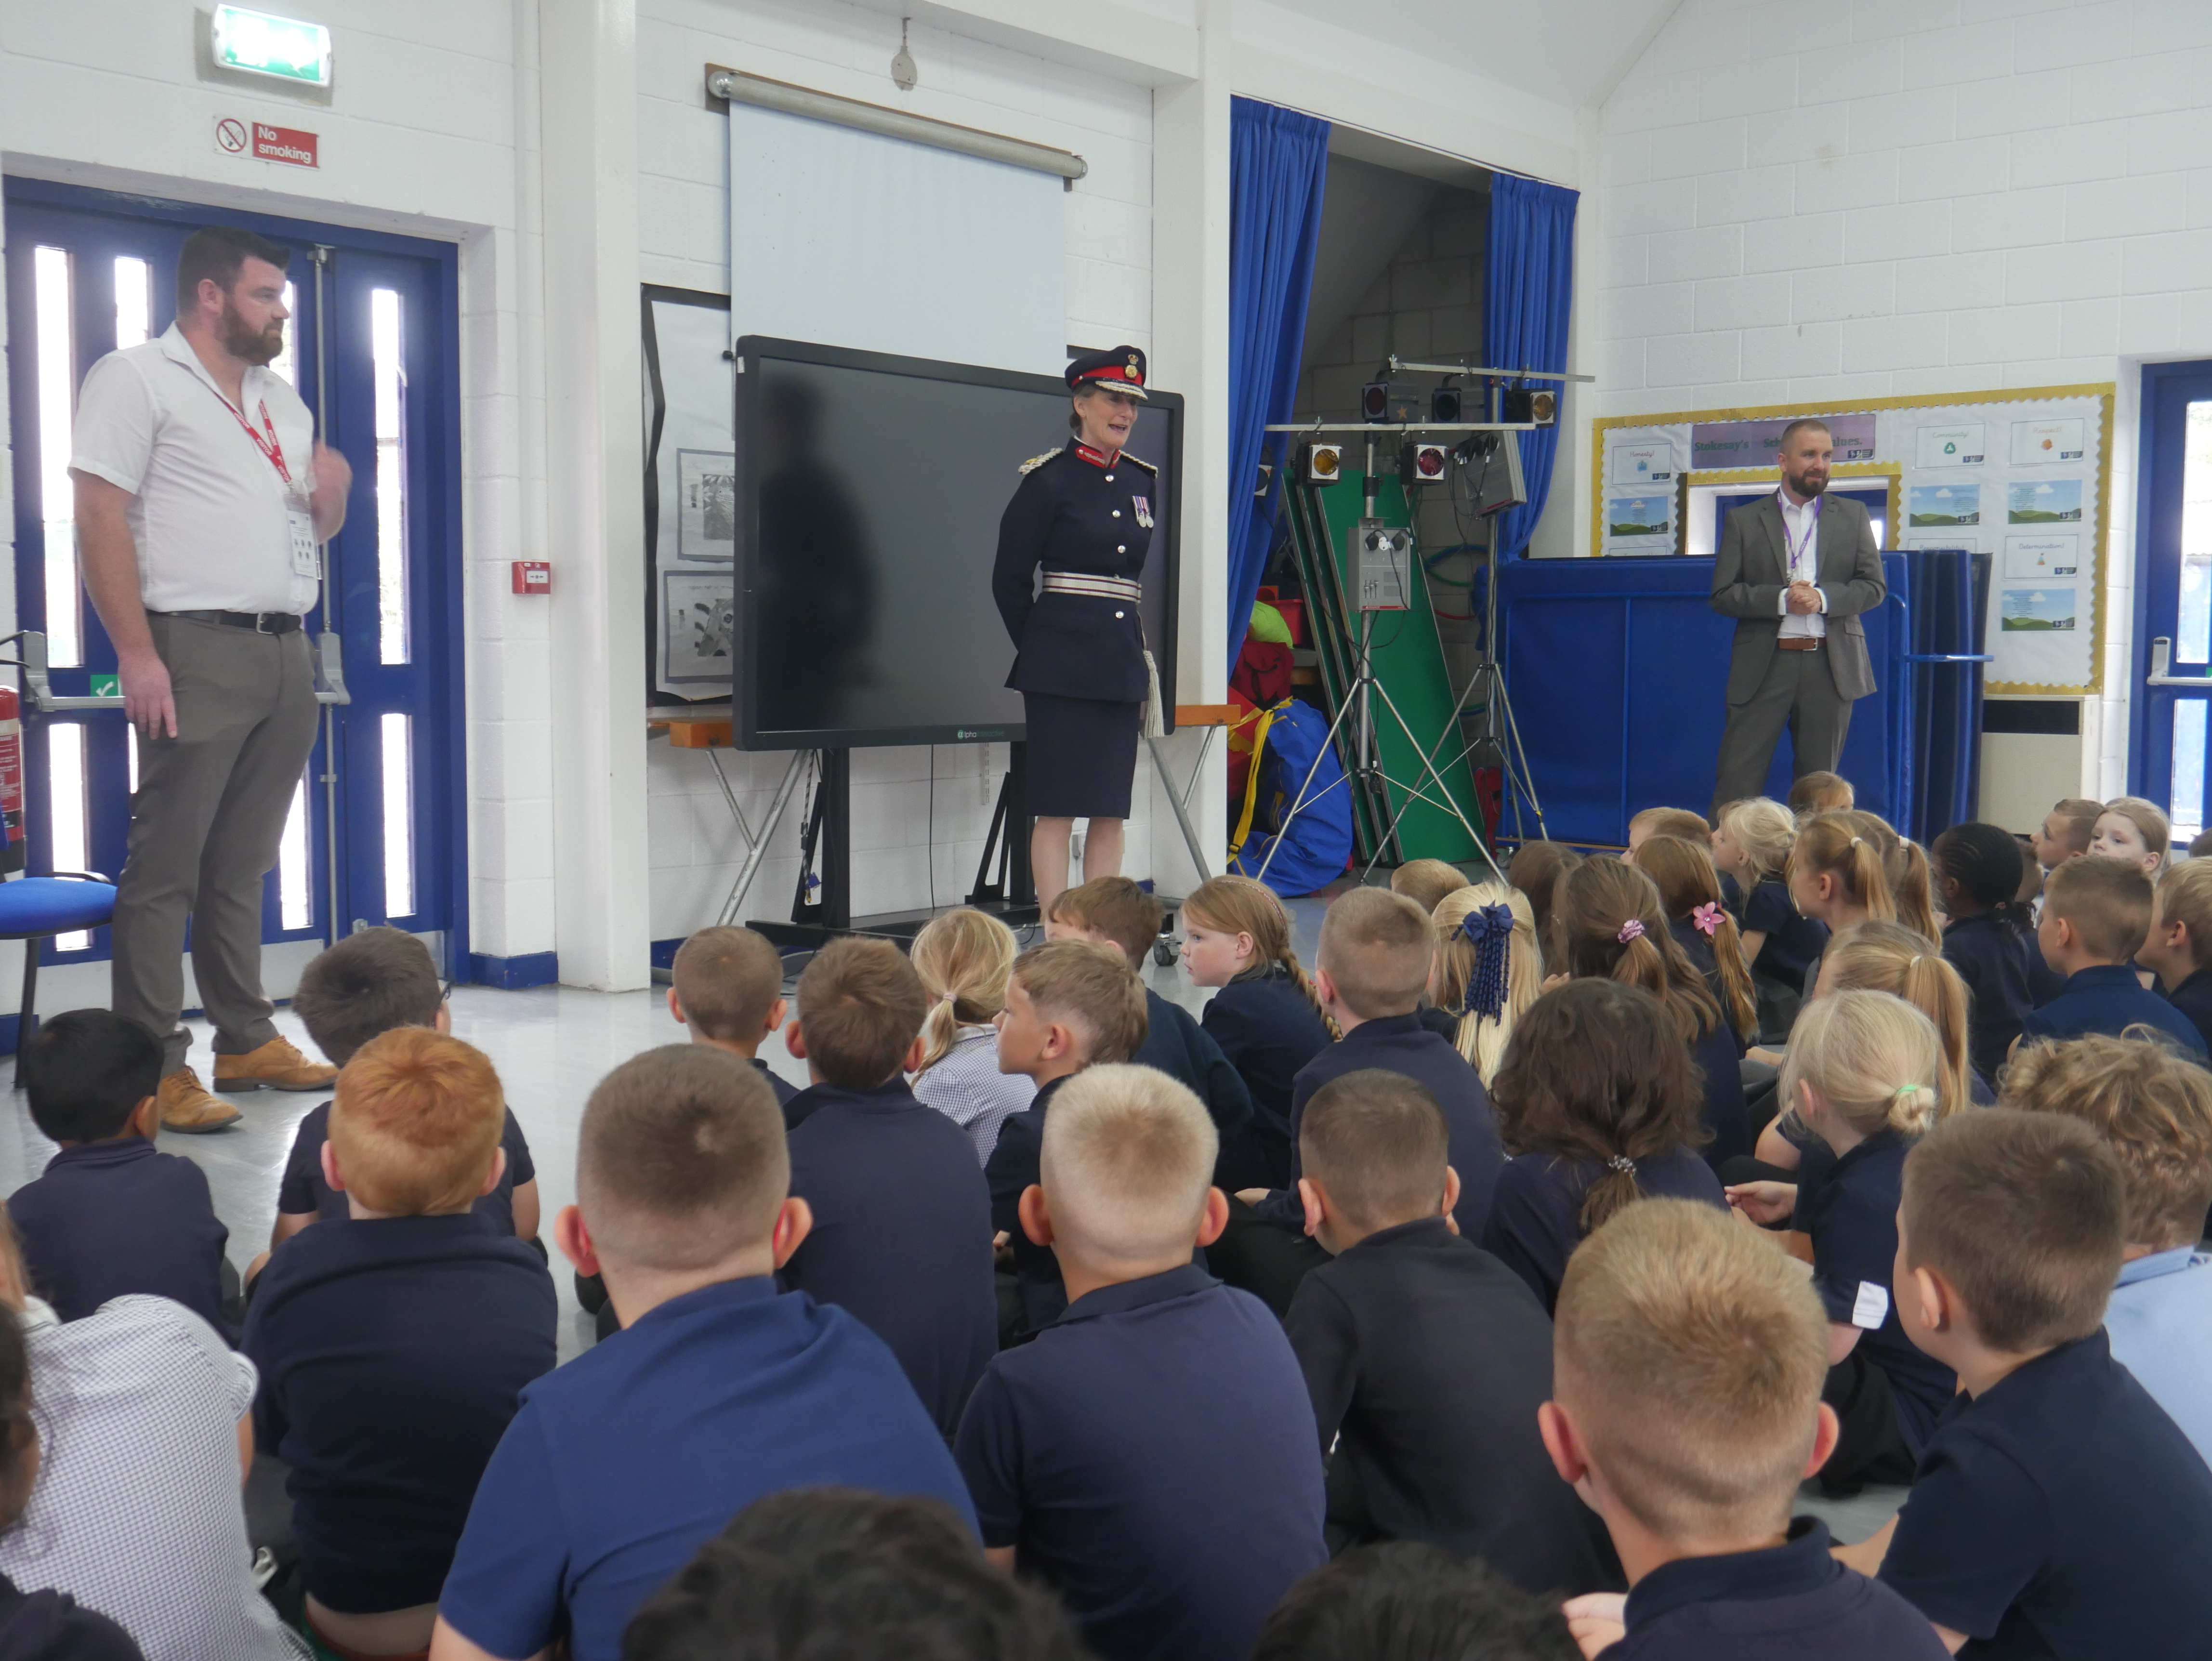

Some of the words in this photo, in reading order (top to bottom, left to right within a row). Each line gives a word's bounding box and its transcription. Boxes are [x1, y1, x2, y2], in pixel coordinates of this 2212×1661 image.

[258, 126, 277, 141] No
[258, 144, 312, 164] smoking
[234, 412, 250, 429] VISITOR
[268, 429, 278, 446] VISITOR
[1933, 431, 1969, 439] Community!
[257, 437, 273, 456] VISITOR
[1694, 439, 1749, 451] Stokesay's
